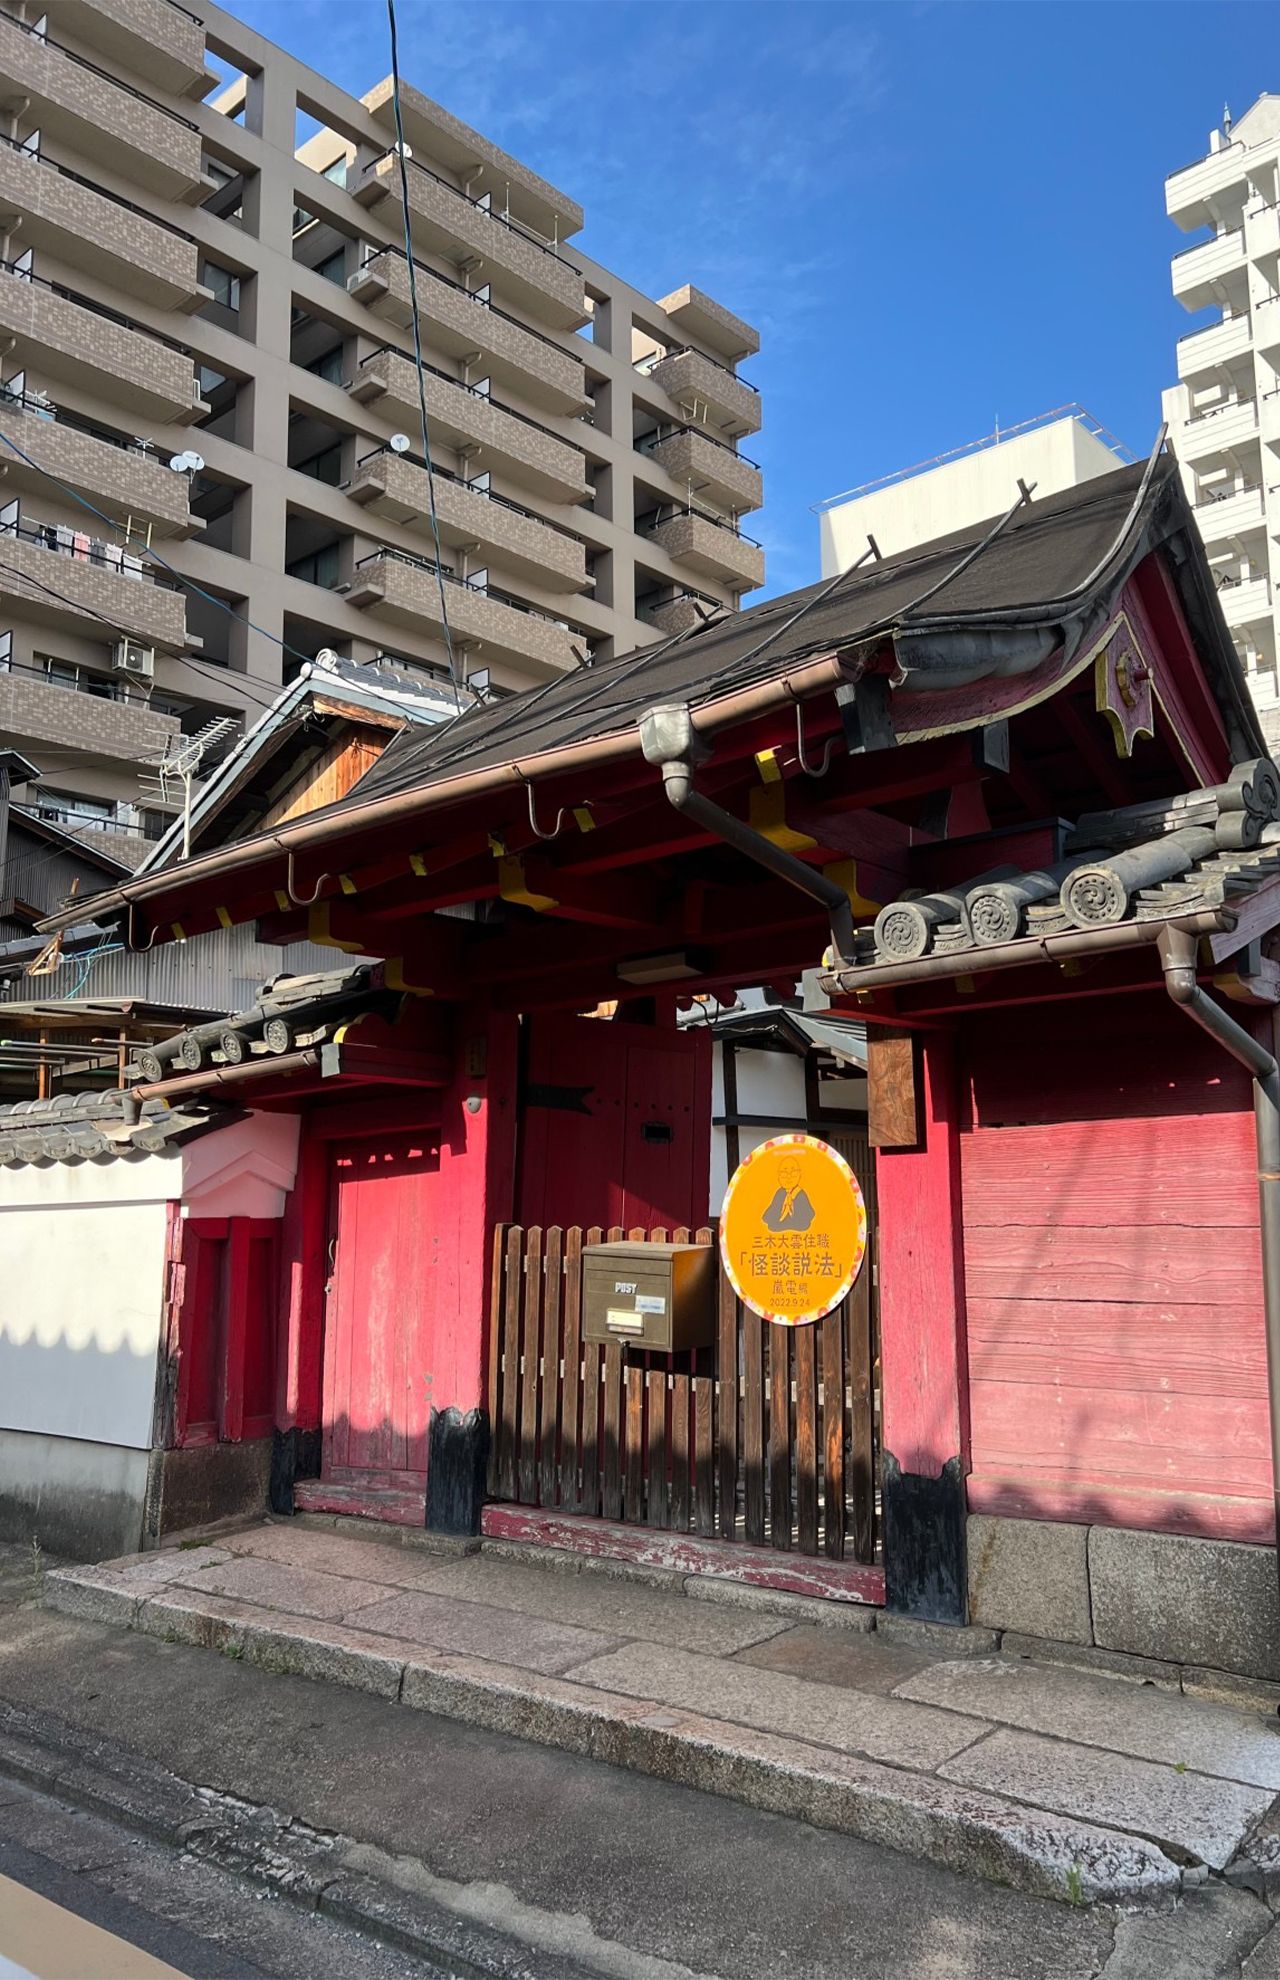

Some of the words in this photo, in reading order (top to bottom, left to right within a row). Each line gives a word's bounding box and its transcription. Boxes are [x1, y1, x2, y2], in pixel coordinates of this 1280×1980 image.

[752, 1234, 829, 1249] 三木大雲住職
[740, 1251, 842, 1278] 「怪談説法」
[615, 1282, 637, 1293] POST
